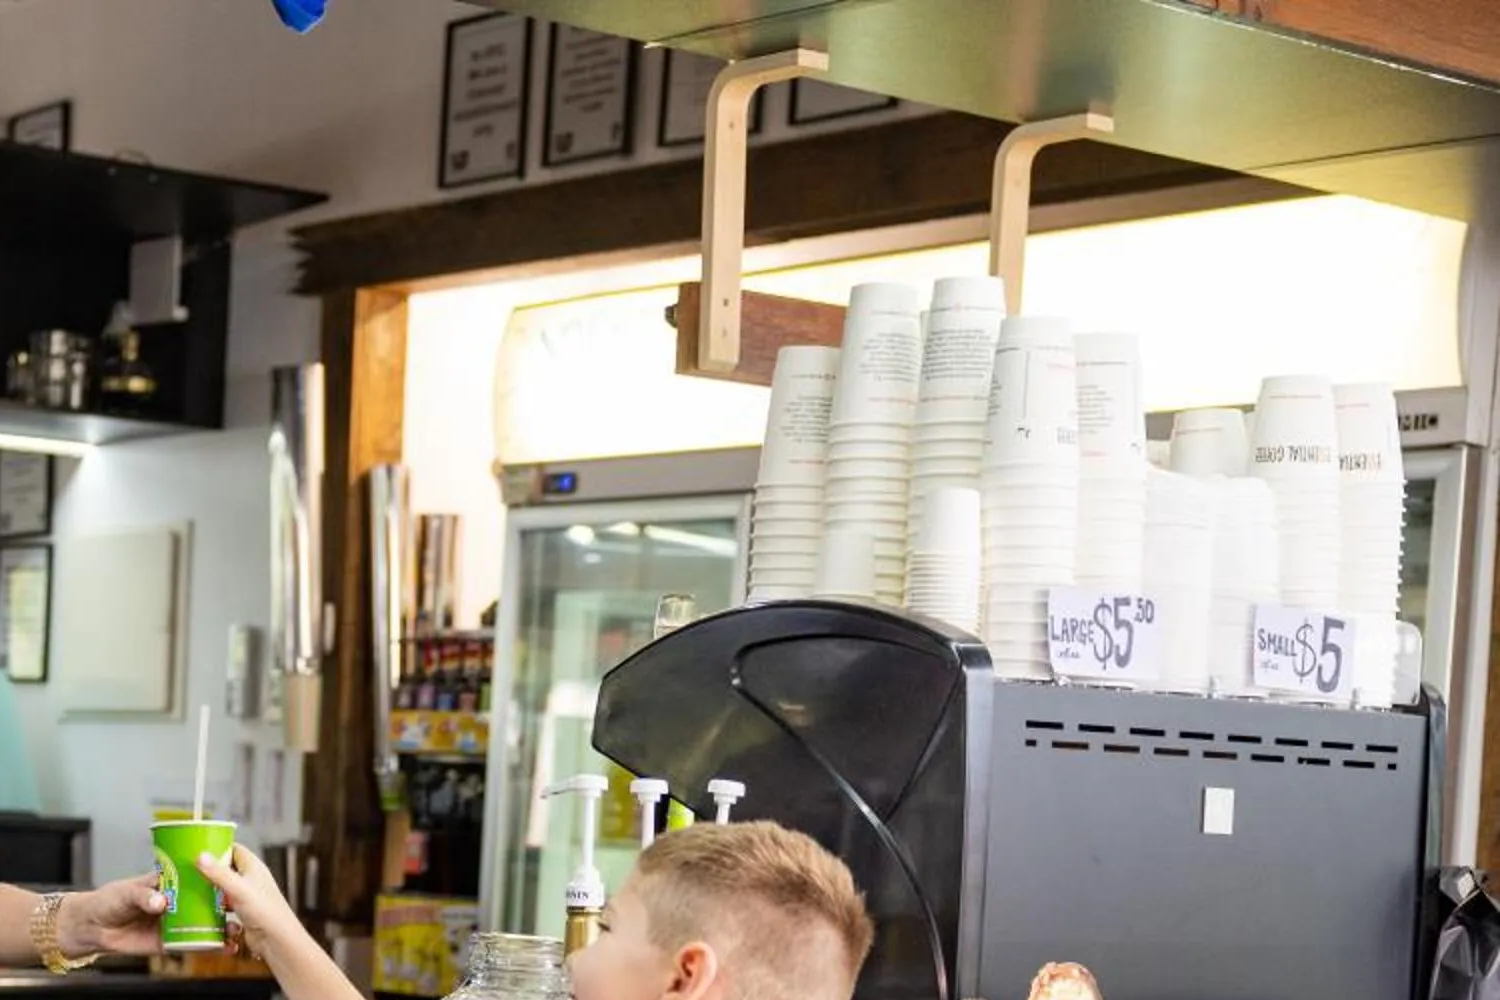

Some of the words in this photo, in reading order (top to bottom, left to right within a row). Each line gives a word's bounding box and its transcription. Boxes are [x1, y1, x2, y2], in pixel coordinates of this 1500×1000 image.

[1050, 615, 1095, 645] LARGE
[1257, 628, 1298, 657] SMALL
[1292, 615, 1345, 693] $5
